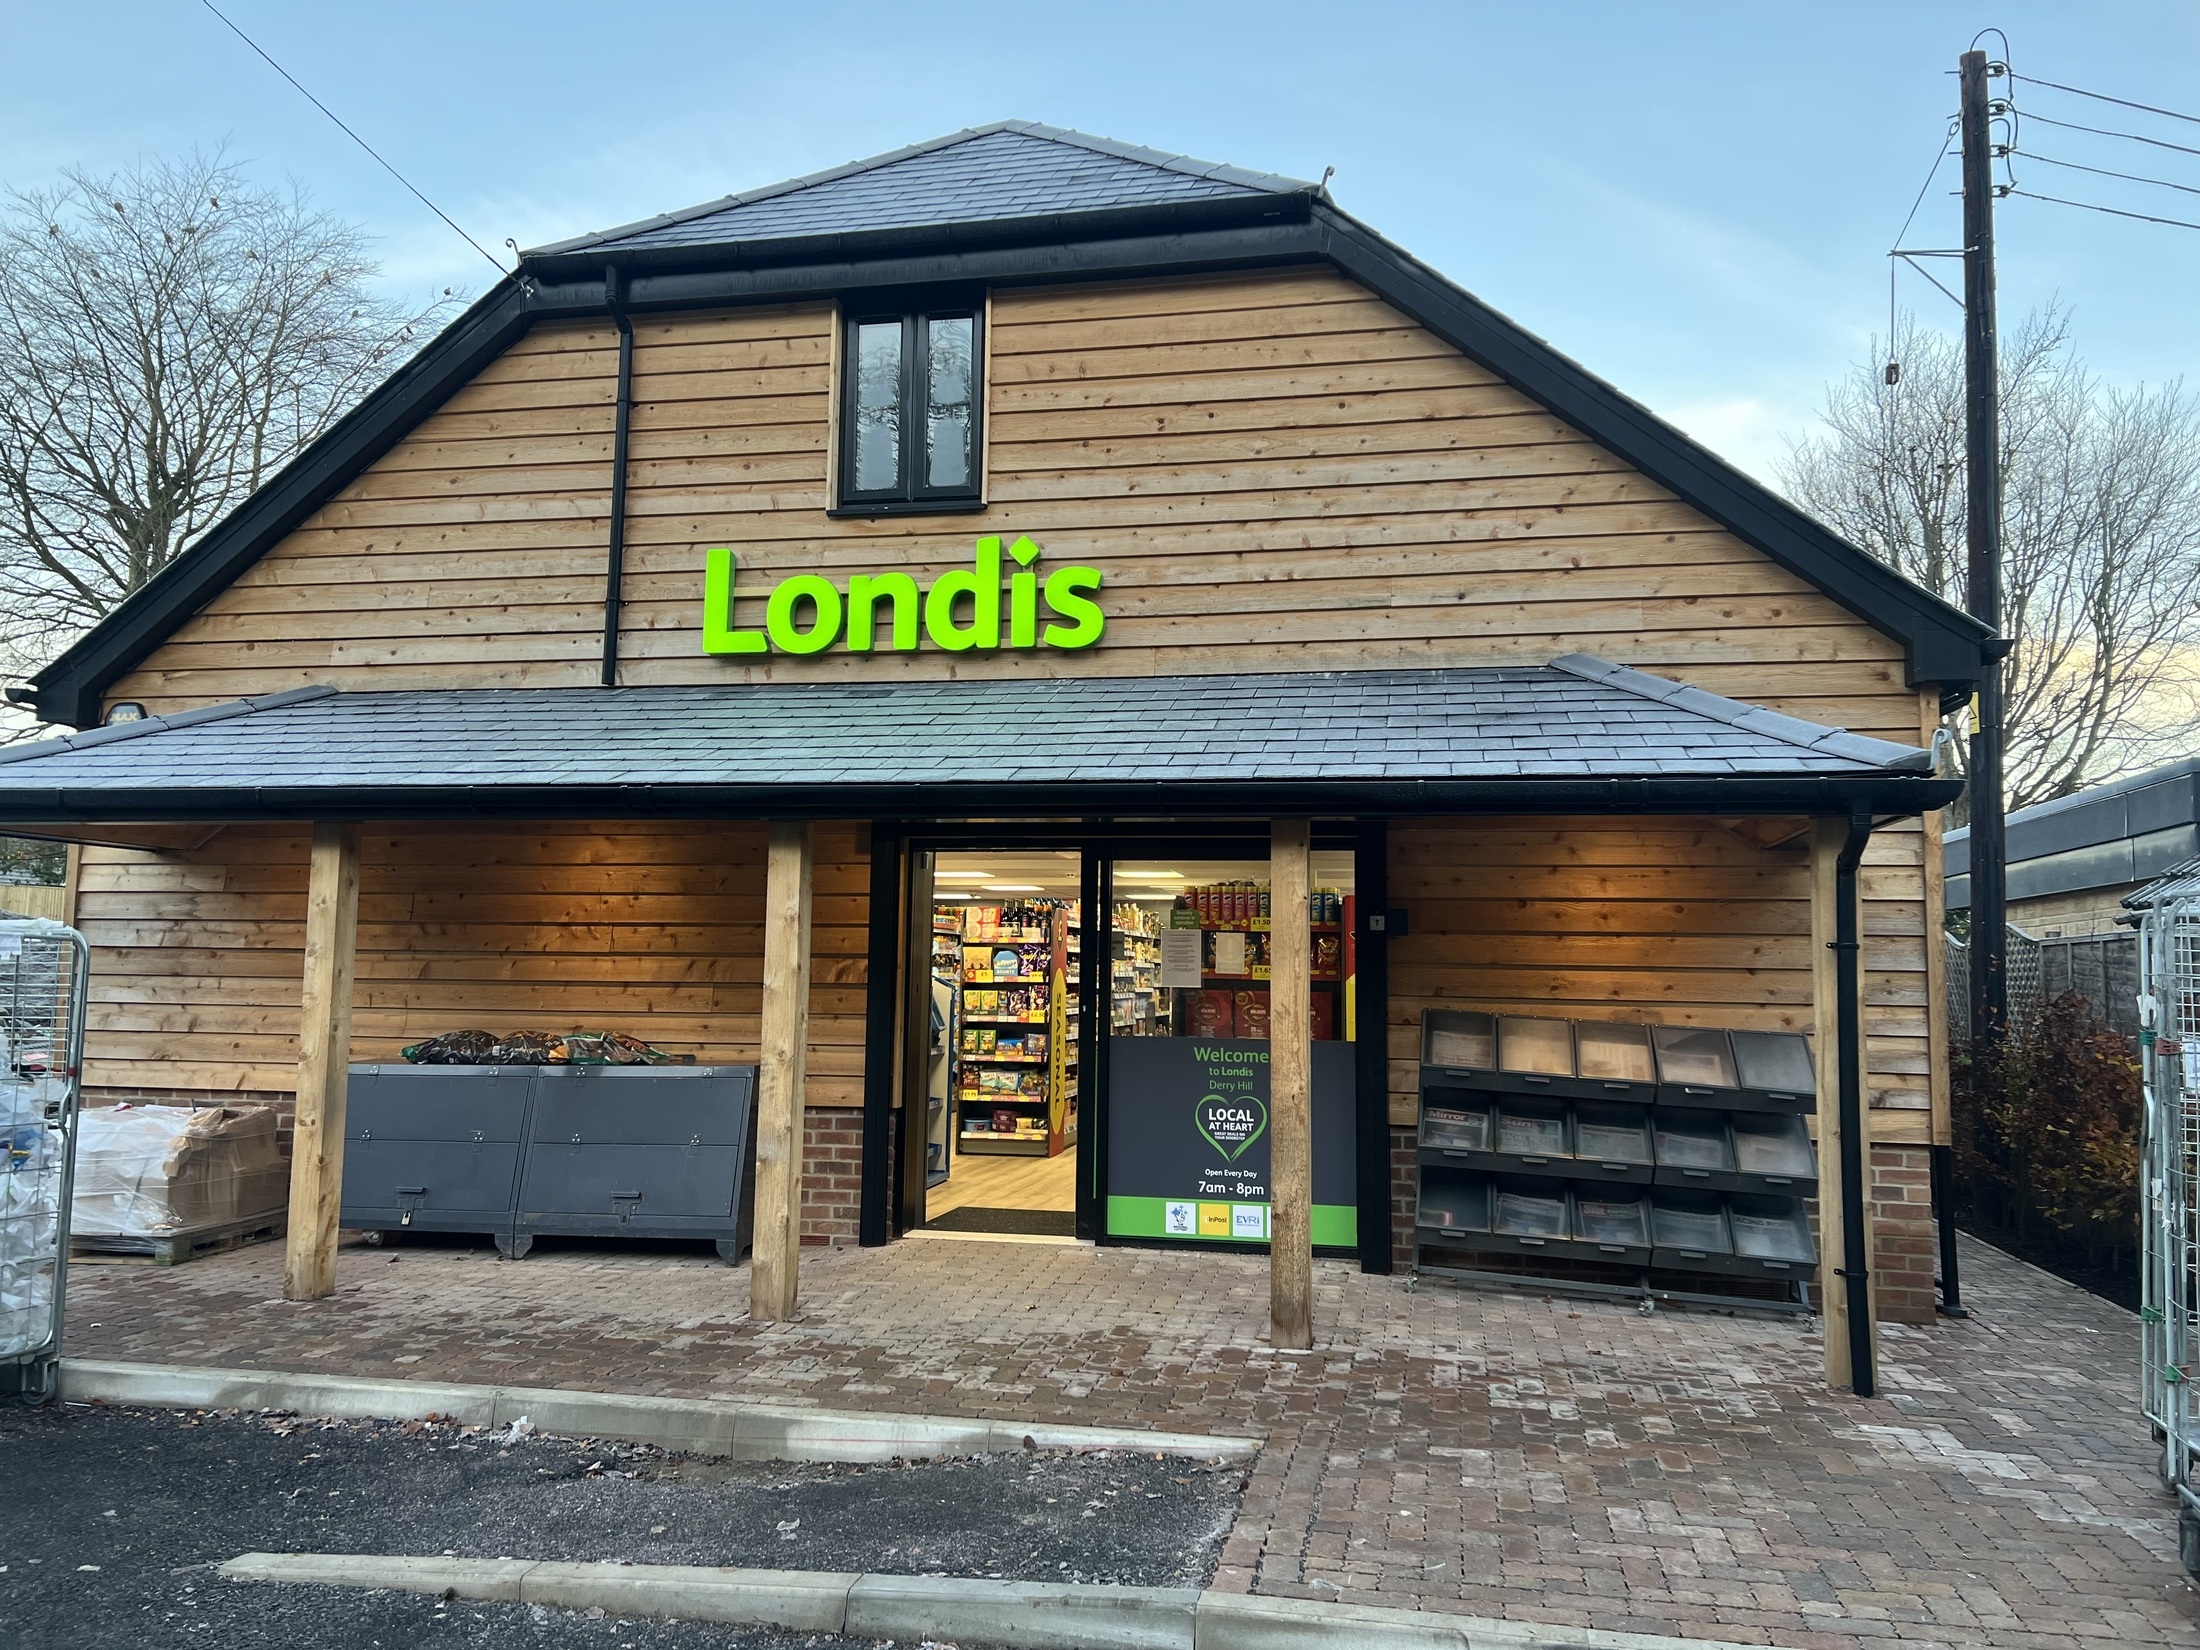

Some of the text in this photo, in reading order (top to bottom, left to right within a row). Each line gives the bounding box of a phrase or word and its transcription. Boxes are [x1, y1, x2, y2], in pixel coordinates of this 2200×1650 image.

[702, 535, 1106, 655] Londis
[1054, 992, 1062, 1111] SEASONAL
[1193, 1046, 1270, 1064] Welcome
[1209, 1066, 1254, 1077] to Londis
[1209, 1080, 1253, 1093] Derry Hill
[1208, 1108, 1255, 1122] LOCAL
[1429, 1110, 1467, 1121] Mirror
[1208, 1121, 1254, 1132] AT HEART
[1501, 1117, 1531, 1127] Sun
[1205, 1168, 1258, 1179] Open Every Day
[1198, 1181, 1226, 1194] 7am
[1236, 1182, 1265, 1197] 8pm
[1735, 1216, 1765, 1226] ACING
